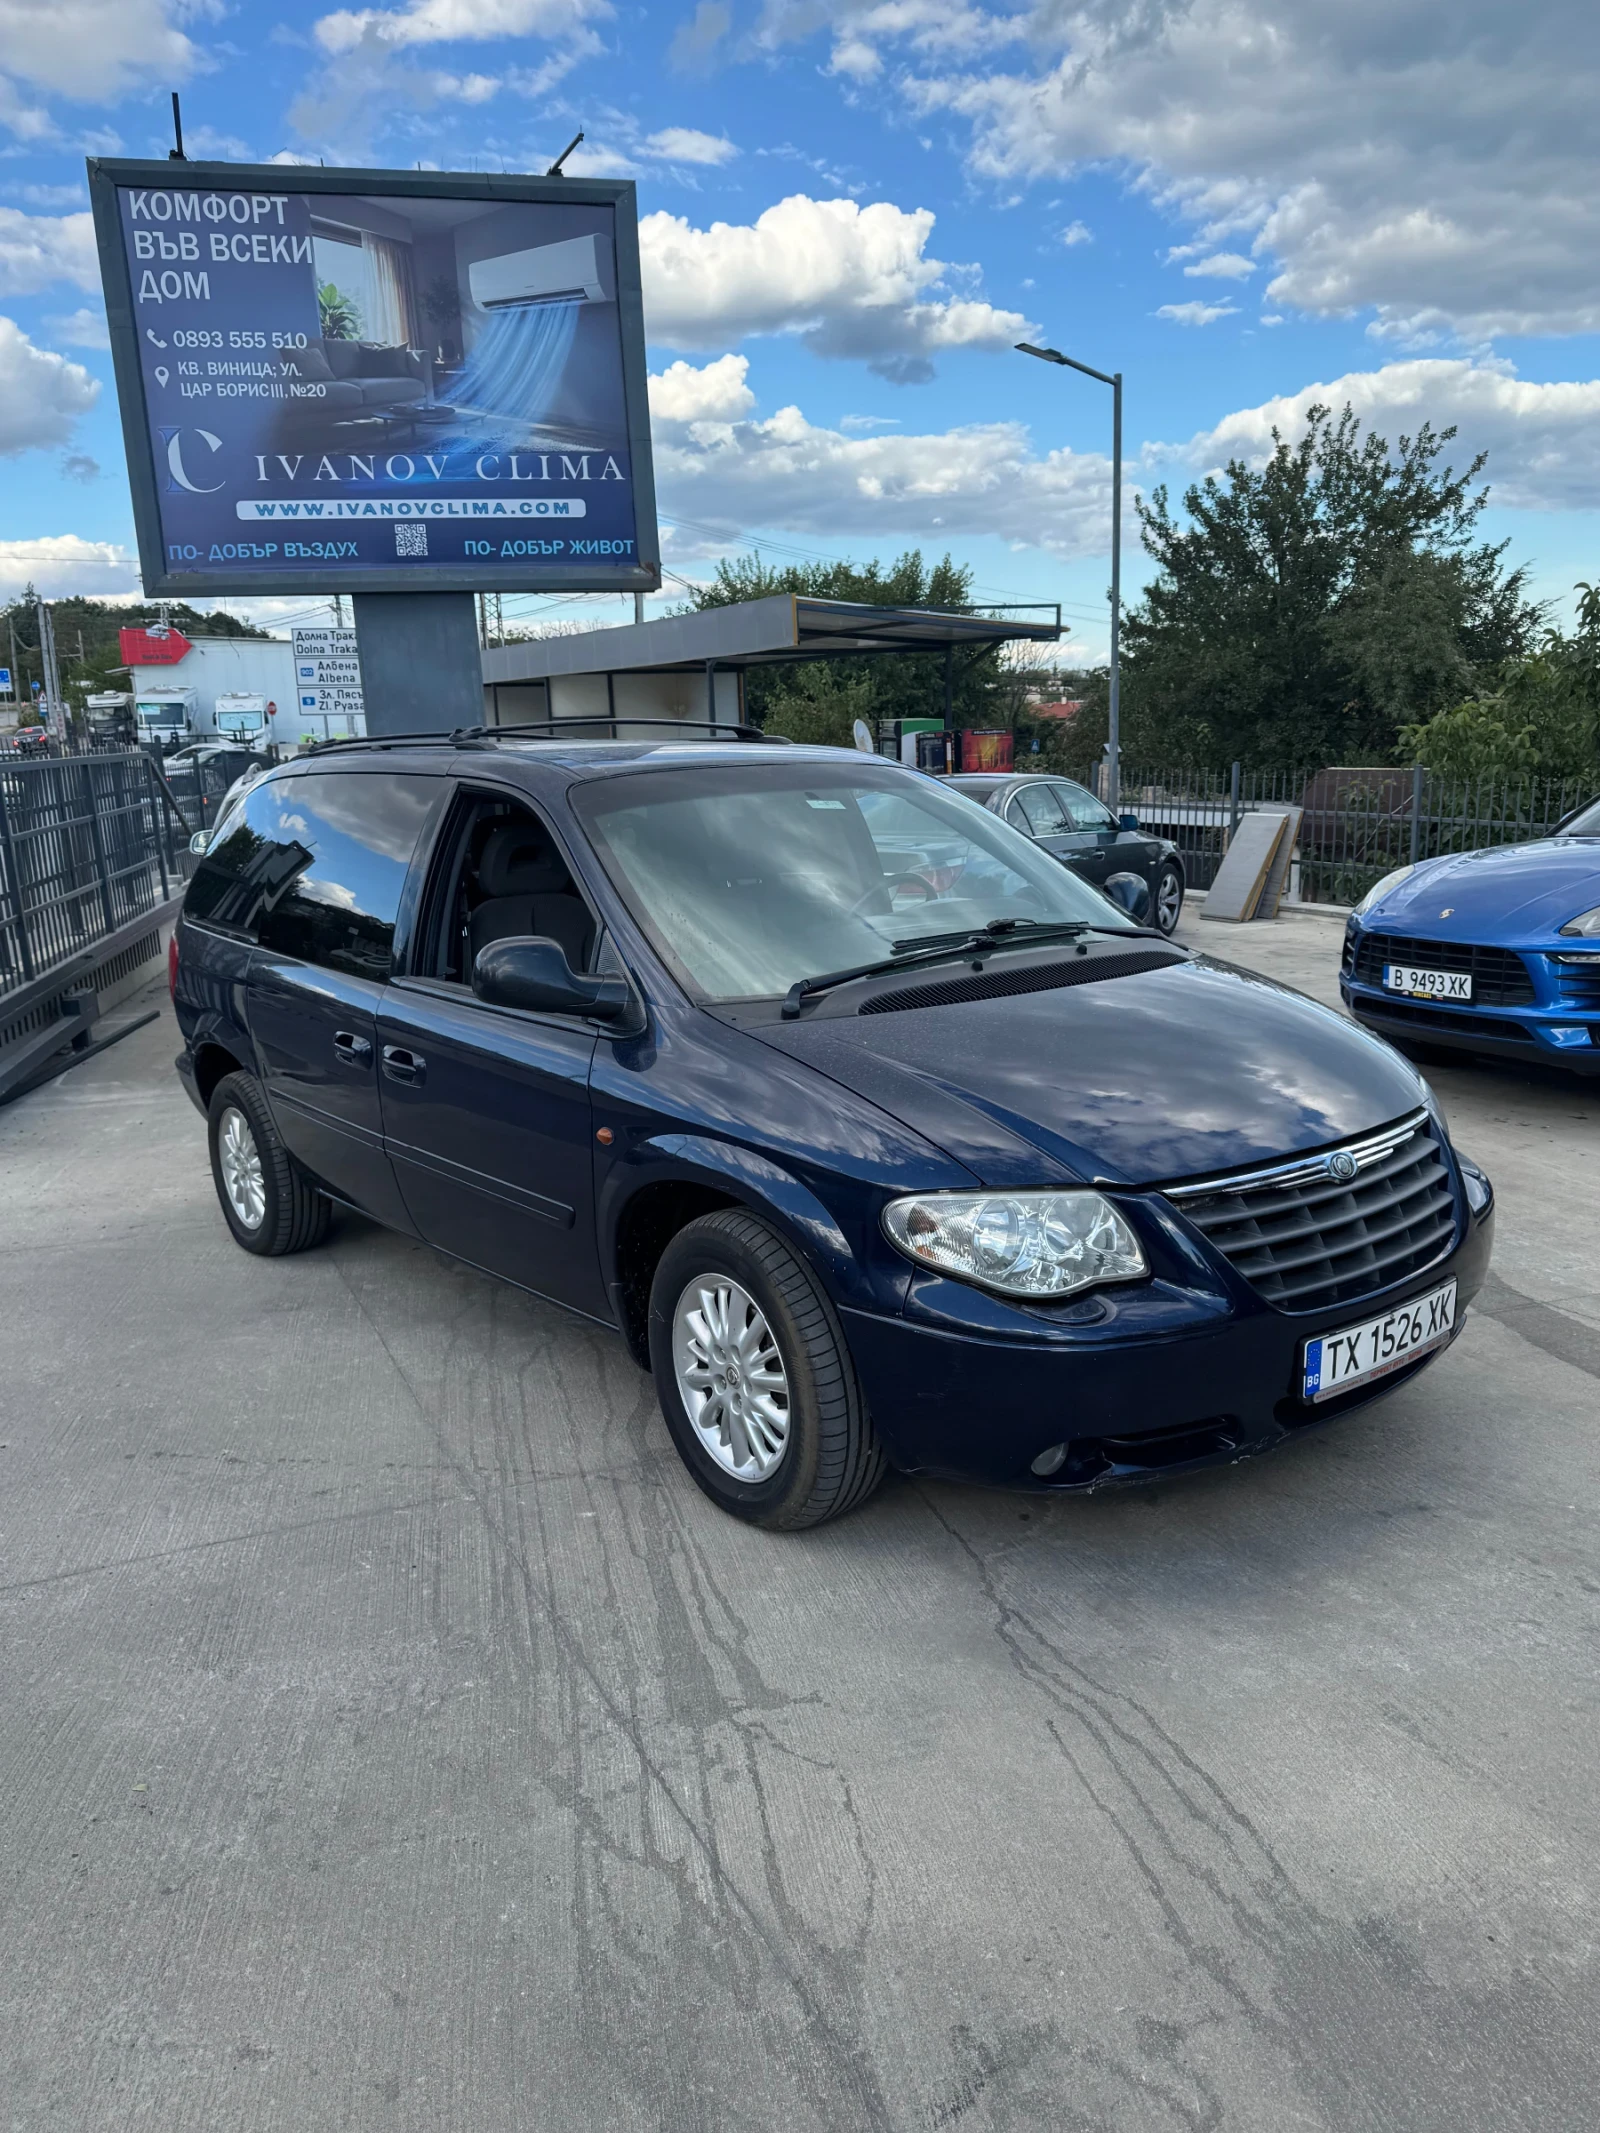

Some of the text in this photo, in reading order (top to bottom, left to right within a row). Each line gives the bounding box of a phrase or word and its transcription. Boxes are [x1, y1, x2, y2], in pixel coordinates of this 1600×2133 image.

[129, 191, 288, 225] КОМФОРТ
[134, 231, 313, 264] ВЪВ ВСЕКИ
[139, 270, 211, 304] ДОМ
[173, 330, 307, 349] 0893 555 510
[178, 362, 203, 376] КВ.
[280, 363, 302, 377] УЛ.
[180, 382, 212, 399] ЦАР
[254, 454, 625, 481] IVANOV CLIMA
[255, 502, 570, 517] WWW.IVANOVCLIMA.COM
[208, 543, 278, 561] ДОБЪР
[284, 541, 358, 559] ВЪЗДУХ
[500, 540, 565, 557] ДОБЪР
[569, 539, 634, 555] ЖИВОТ
[296, 631, 328, 642] Долна
[296, 644, 325, 654] Dolna
[318, 661, 358, 670] Албена
[318, 673, 355, 683] Albena
[1394, 969, 1468, 996] B 9493 XK
[1327, 1331, 1362, 1380] TX
[1371, 1305, 1422, 1364] 1526
[1426, 1289, 1453, 1337] XK
[1307, 1373, 1320, 1388] BG
